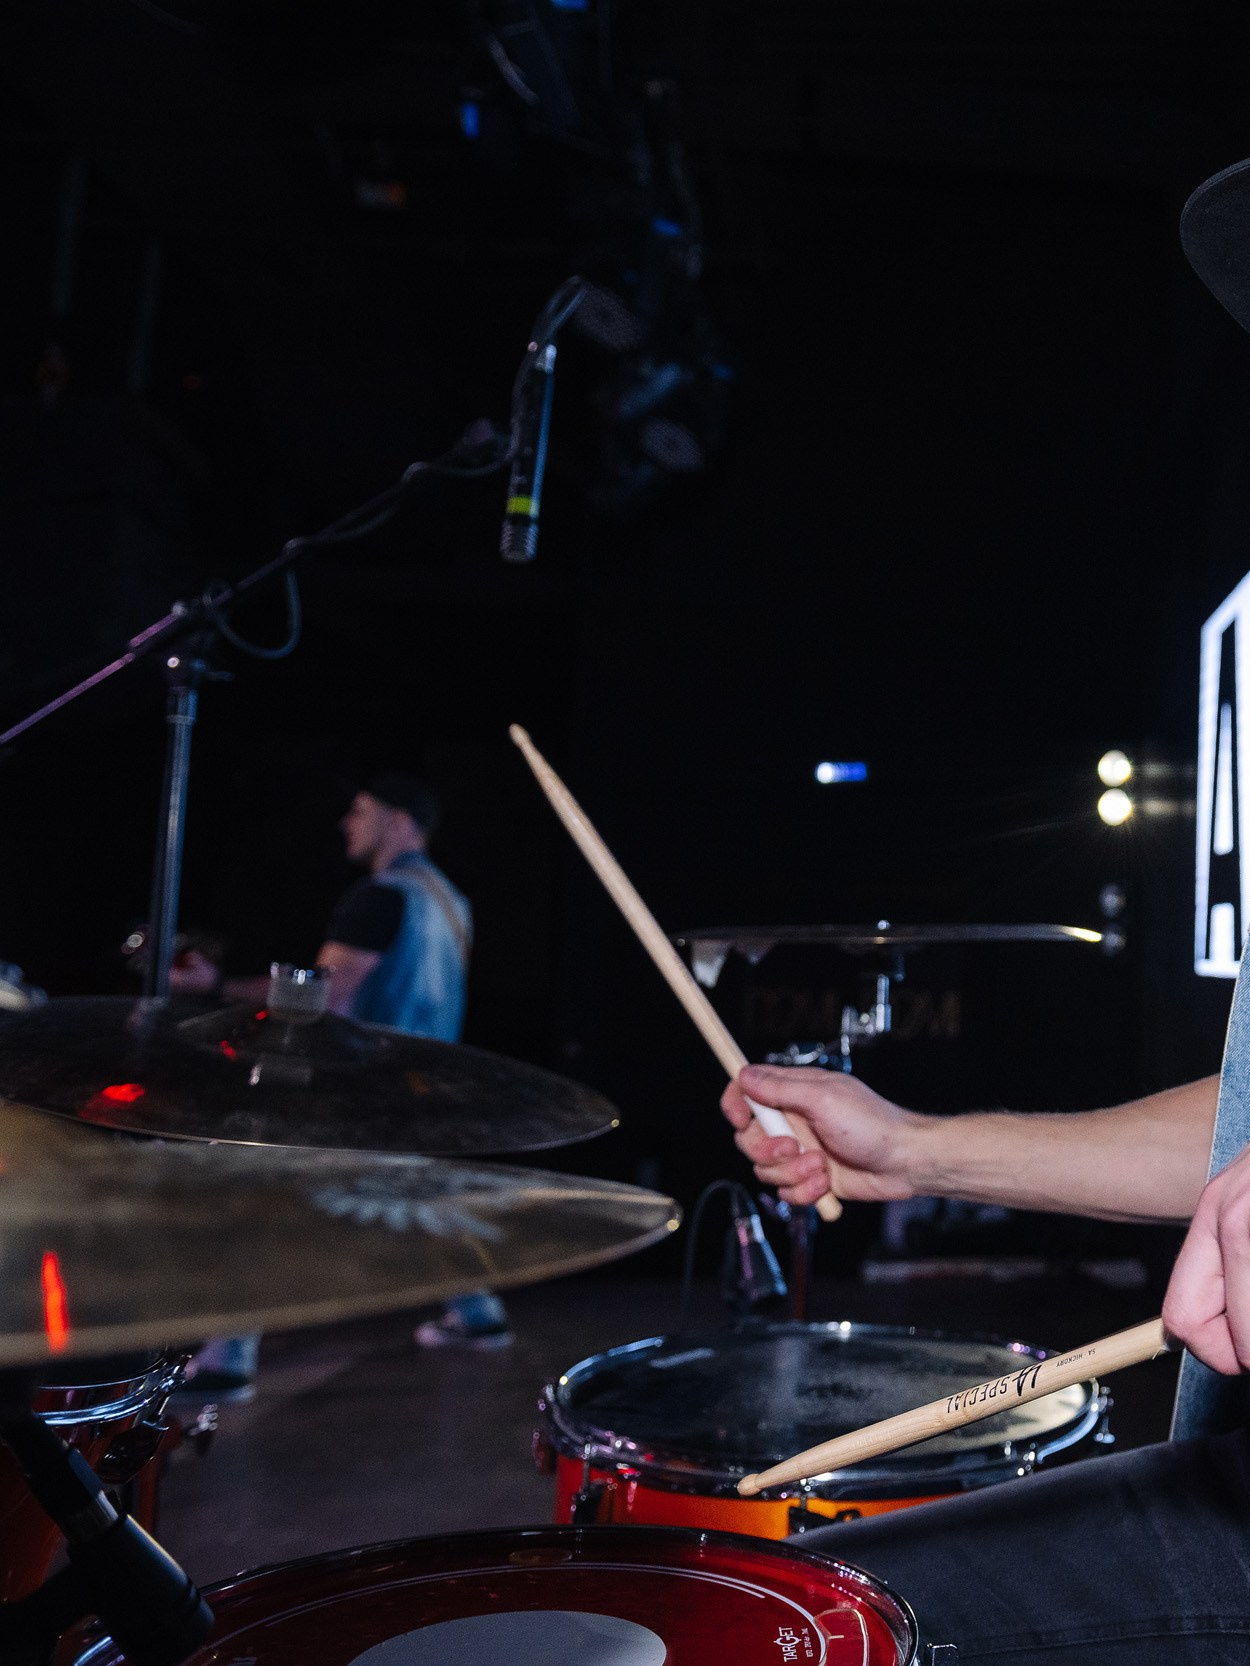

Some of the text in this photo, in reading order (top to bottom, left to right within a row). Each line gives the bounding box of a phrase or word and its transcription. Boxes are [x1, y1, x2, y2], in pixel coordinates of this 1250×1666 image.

[1056, 1353, 1083, 1368] HICKORY
[947, 1364, 1043, 1414] LA SPECIAL
[773, 1626, 802, 1663] TARGET
